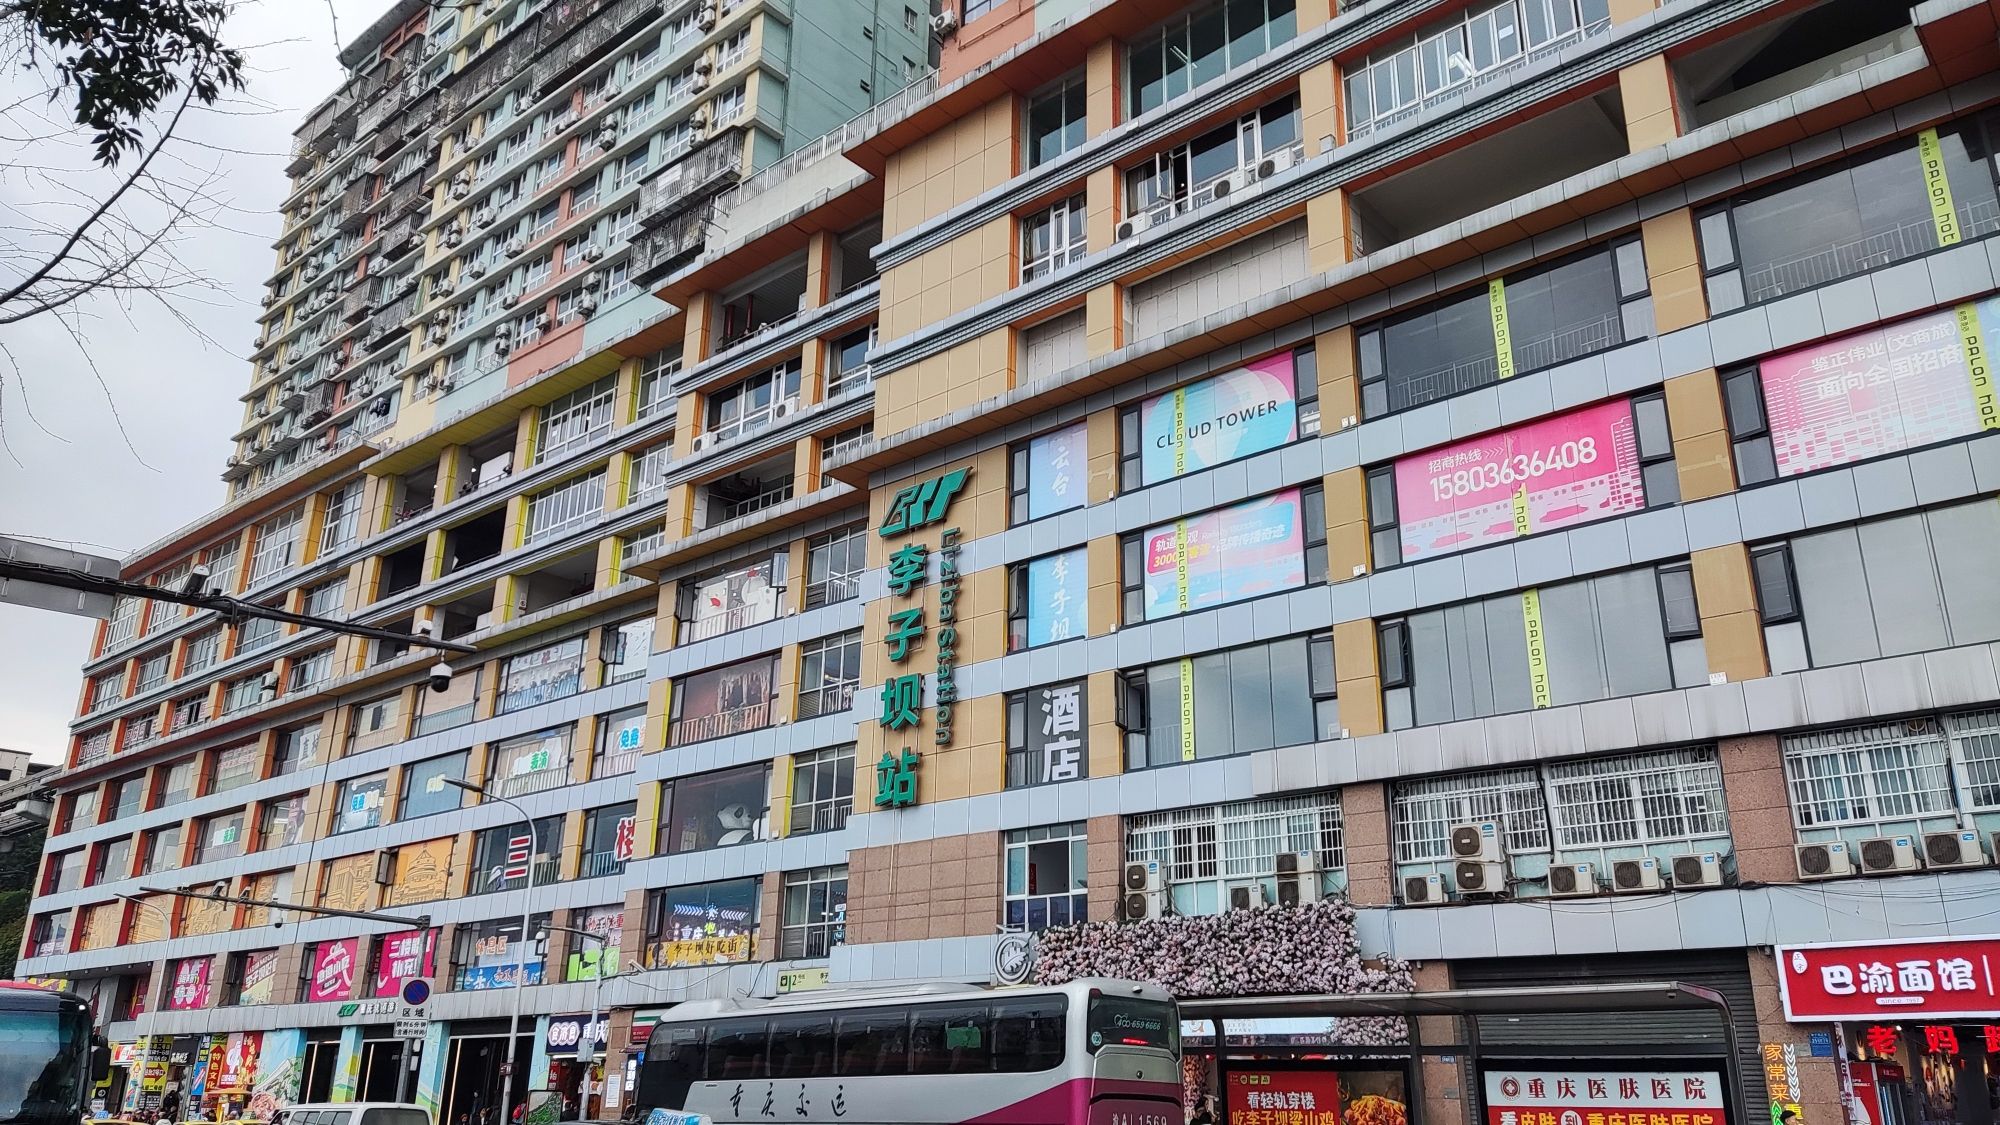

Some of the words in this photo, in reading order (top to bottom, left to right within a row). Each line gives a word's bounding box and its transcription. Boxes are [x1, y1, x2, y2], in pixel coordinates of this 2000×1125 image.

[1156, 421, 1211, 450] CLUD
[1216, 399, 1278, 431] TOWER
[1428, 446, 1483, 473] 招商热线
[1429, 436, 1598, 503] 15803636408
[875, 542, 929, 808] 李子坝站
[1041, 684, 1081, 784] 酒店
[1820, 957, 1977, 995] 巴渝面馆
[402, 1007, 425, 1017] 区域
[1527, 1077, 1707, 1100] 重庆医肤医院
[1764, 1042, 1790, 1101] 家常菜
[1247, 1091, 1316, 1111] 看轻轨穿楼
